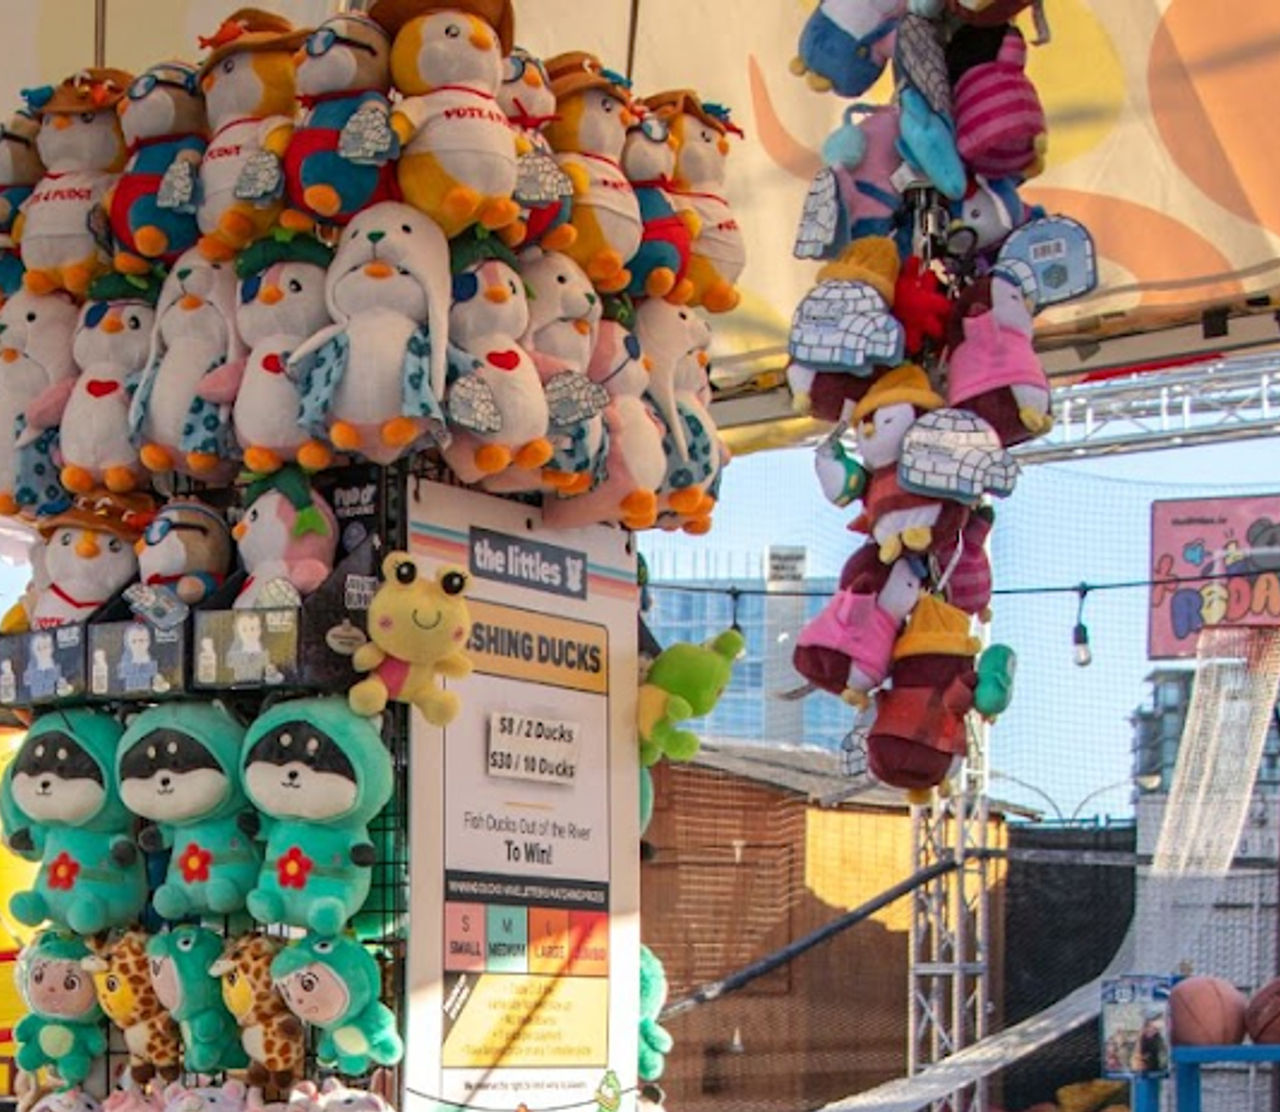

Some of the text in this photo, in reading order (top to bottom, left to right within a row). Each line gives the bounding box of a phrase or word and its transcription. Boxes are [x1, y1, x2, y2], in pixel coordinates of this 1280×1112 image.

[474, 538, 562, 587] the littles
[467, 621, 602, 674] SHING DUCKS
[524, 720, 534, 739] 2
[535, 721, 575, 744] Ducks
[539, 757, 576, 778] Ducks
[464, 811, 484, 830] Fish
[486, 813, 518, 835] Ducks
[520, 818, 537, 837] Out
[552, 821, 567, 839] the
[568, 822, 593, 841] River
[504, 840, 554, 865] To Win!
[461, 914, 472, 933] S
